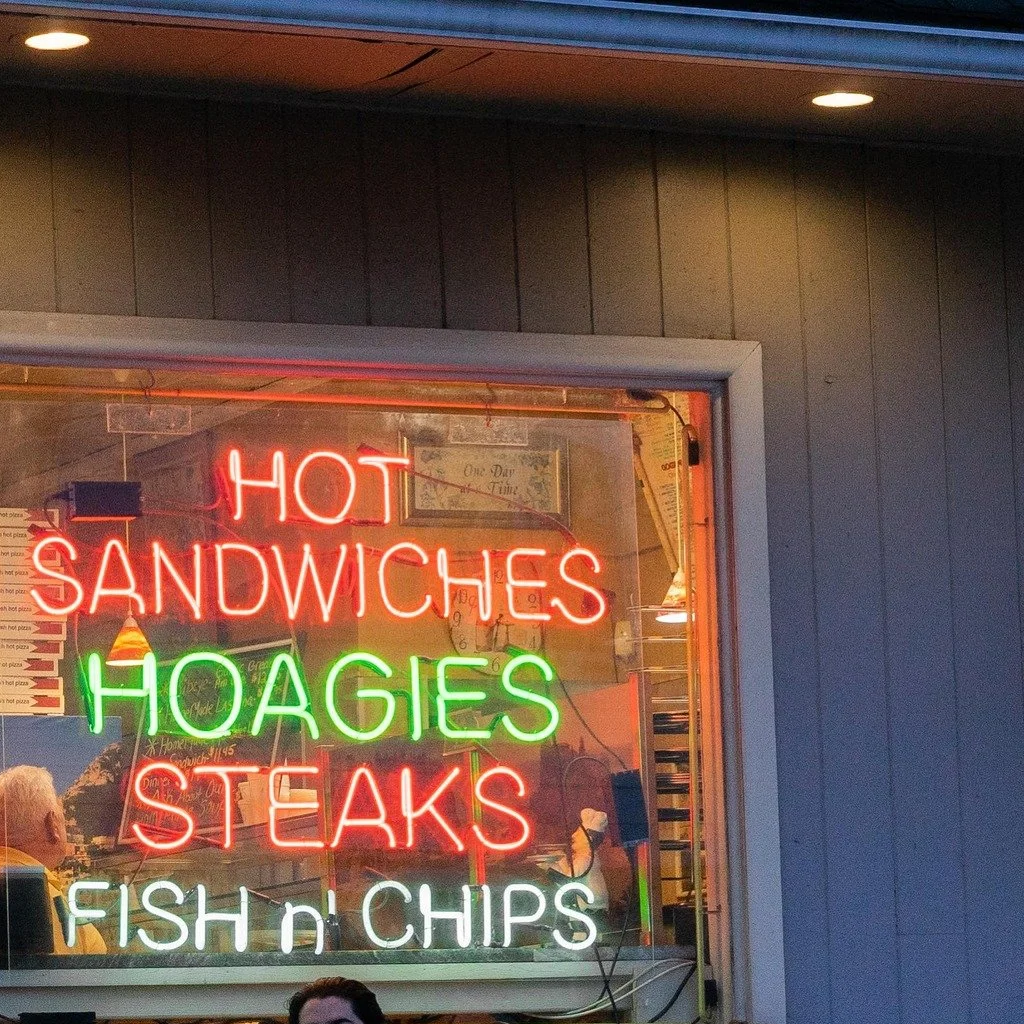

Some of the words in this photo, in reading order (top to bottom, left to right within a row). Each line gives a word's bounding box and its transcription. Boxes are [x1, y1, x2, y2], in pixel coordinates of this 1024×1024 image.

[229, 448, 411, 525] HOT
[30, 536, 606, 625] SANDWICHES
[88, 650, 560, 742] HOAGIES
[131, 762, 530, 853] STEAKS
[66, 880, 249, 953] FISH
[362, 880, 598, 951] CHIPS
